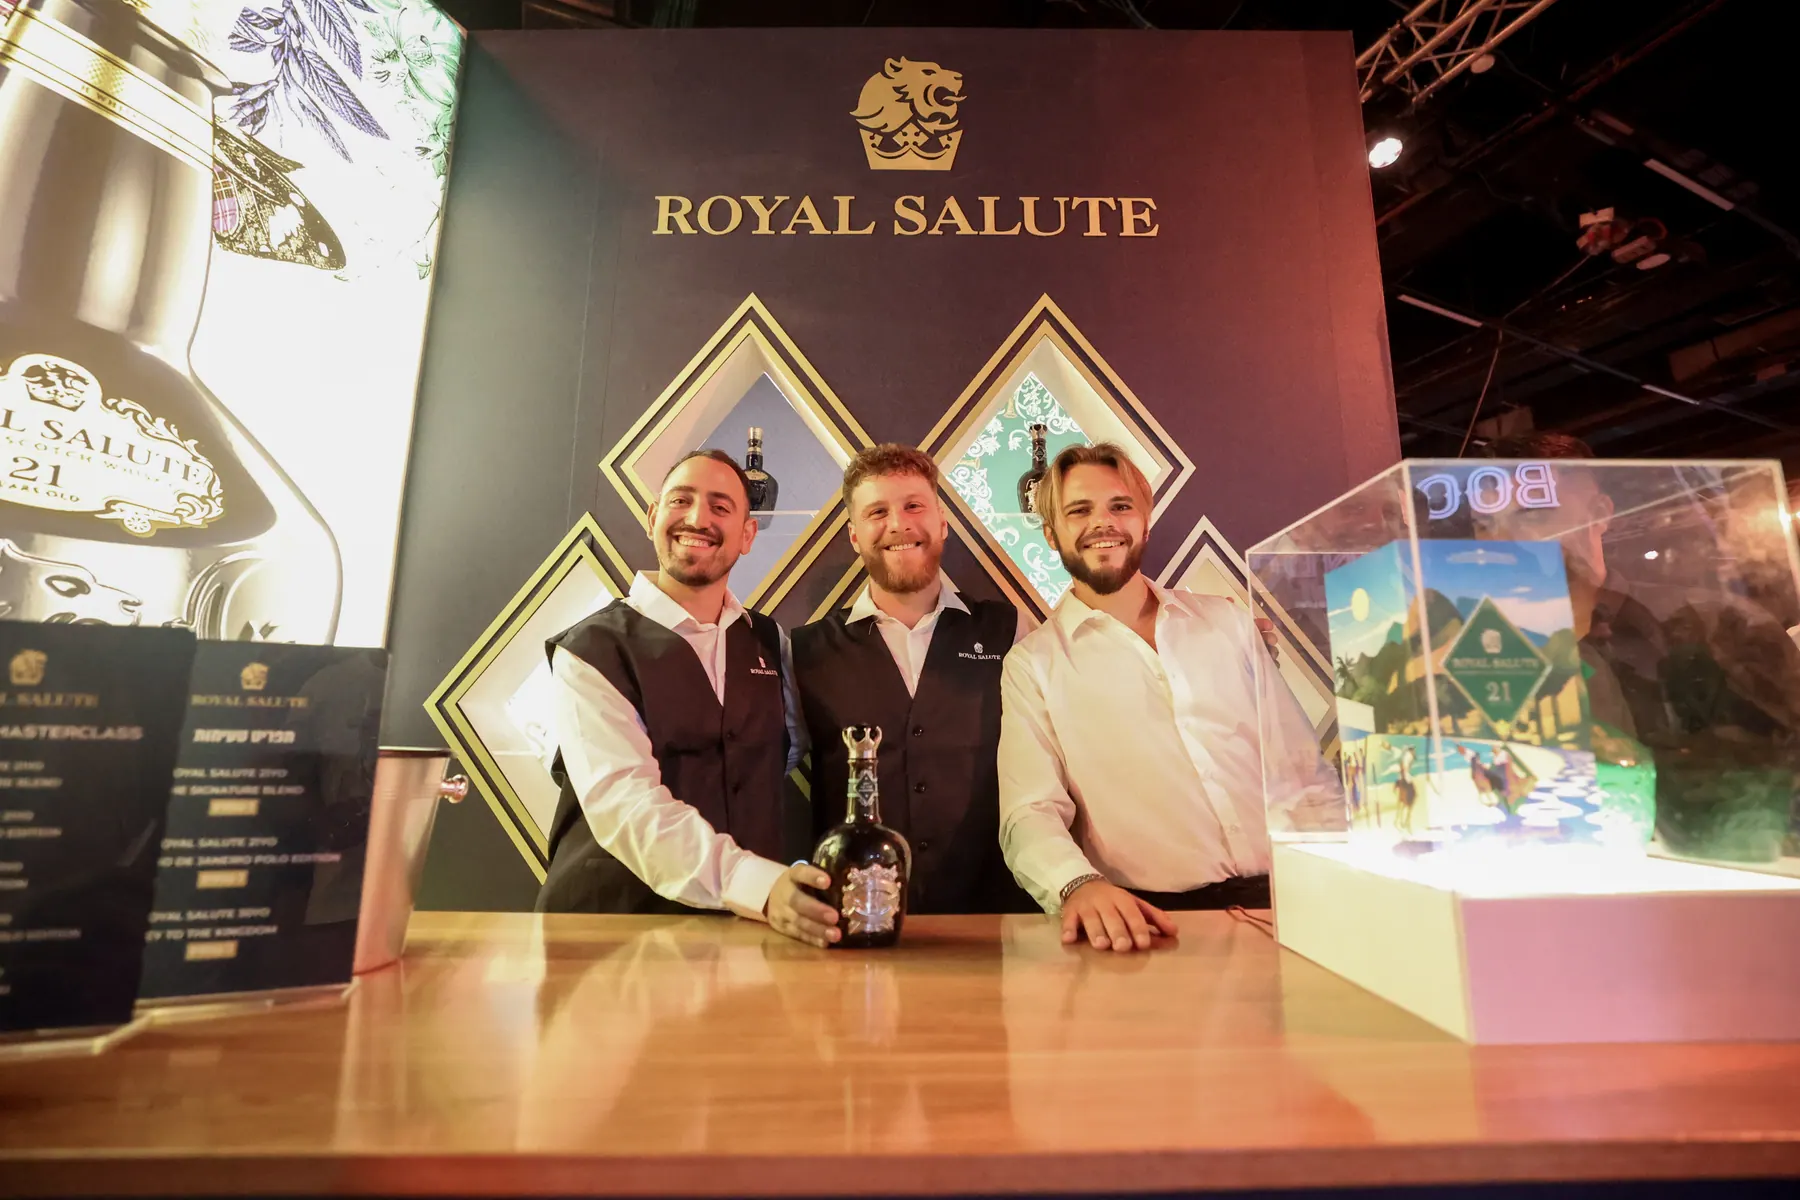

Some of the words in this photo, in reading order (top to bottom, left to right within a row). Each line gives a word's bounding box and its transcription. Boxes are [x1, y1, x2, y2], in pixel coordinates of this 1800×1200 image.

[652, 195, 876, 236] ROYAL
[893, 195, 1160, 238] SALUTE
[40, 419, 202, 486] SALUTE
[9, 456, 64, 488] 21
[45, 489, 80, 502] OLD
[958, 652, 977, 660] ROYAL
[1485, 681, 1512, 703] 21
[172, 768, 206, 779] OYAL
[160, 838, 194, 850] OYAL
[148, 911, 182, 923] OYAL
